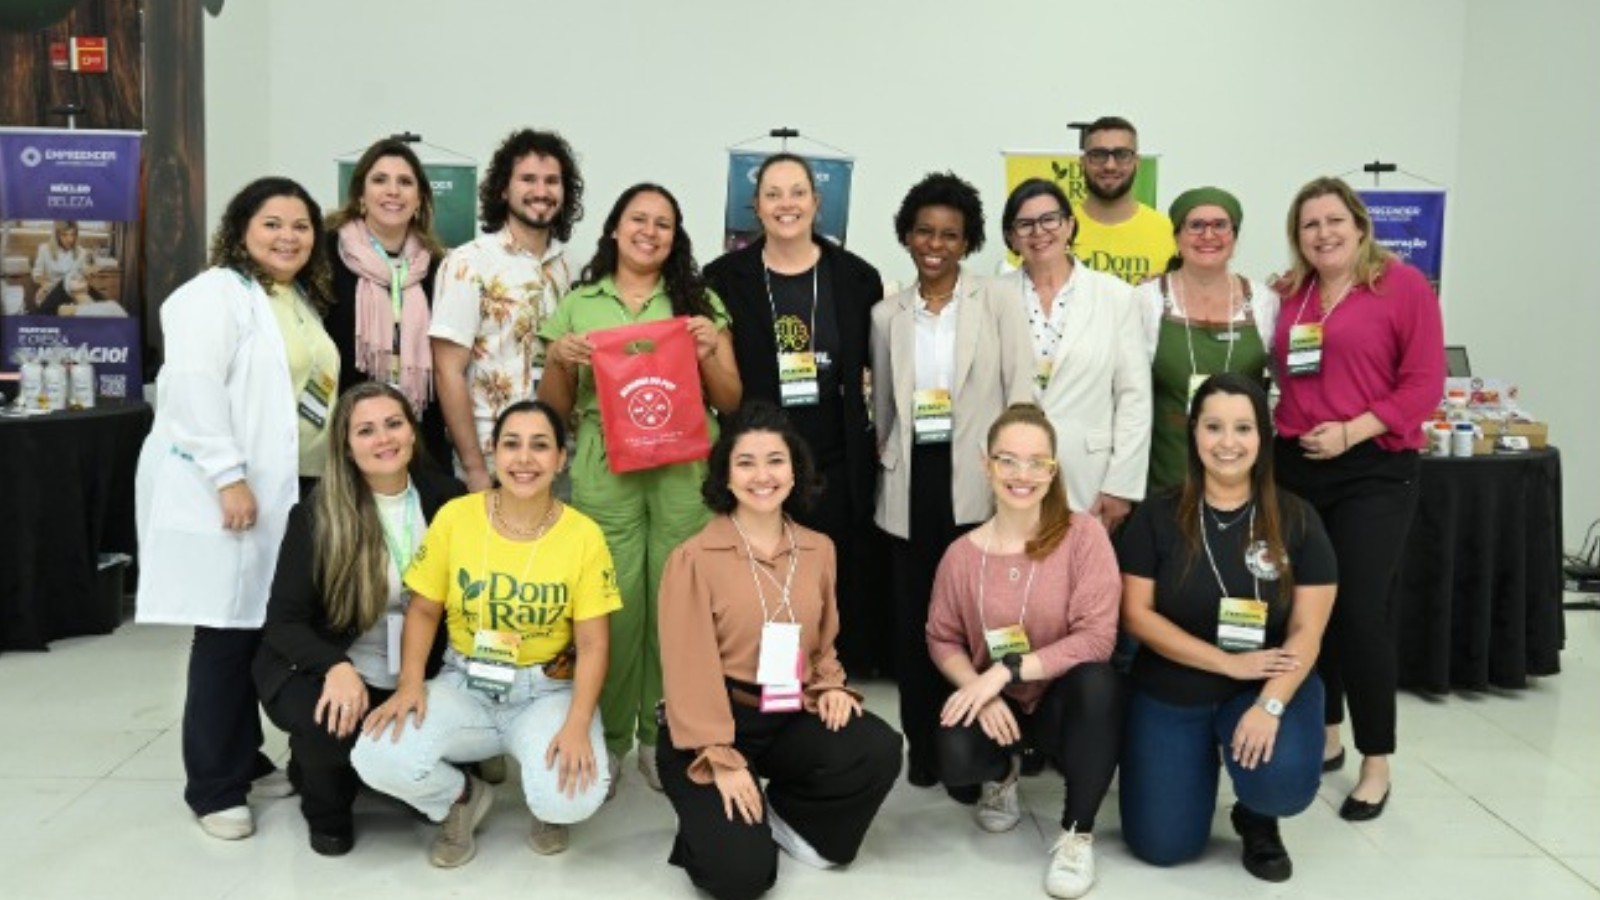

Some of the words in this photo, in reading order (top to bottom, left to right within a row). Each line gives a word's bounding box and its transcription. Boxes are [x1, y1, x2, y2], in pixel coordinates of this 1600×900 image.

[1092, 250, 1149, 271] Dom
[488, 572, 568, 603] Dom
[488, 602, 567, 632] Raiz
